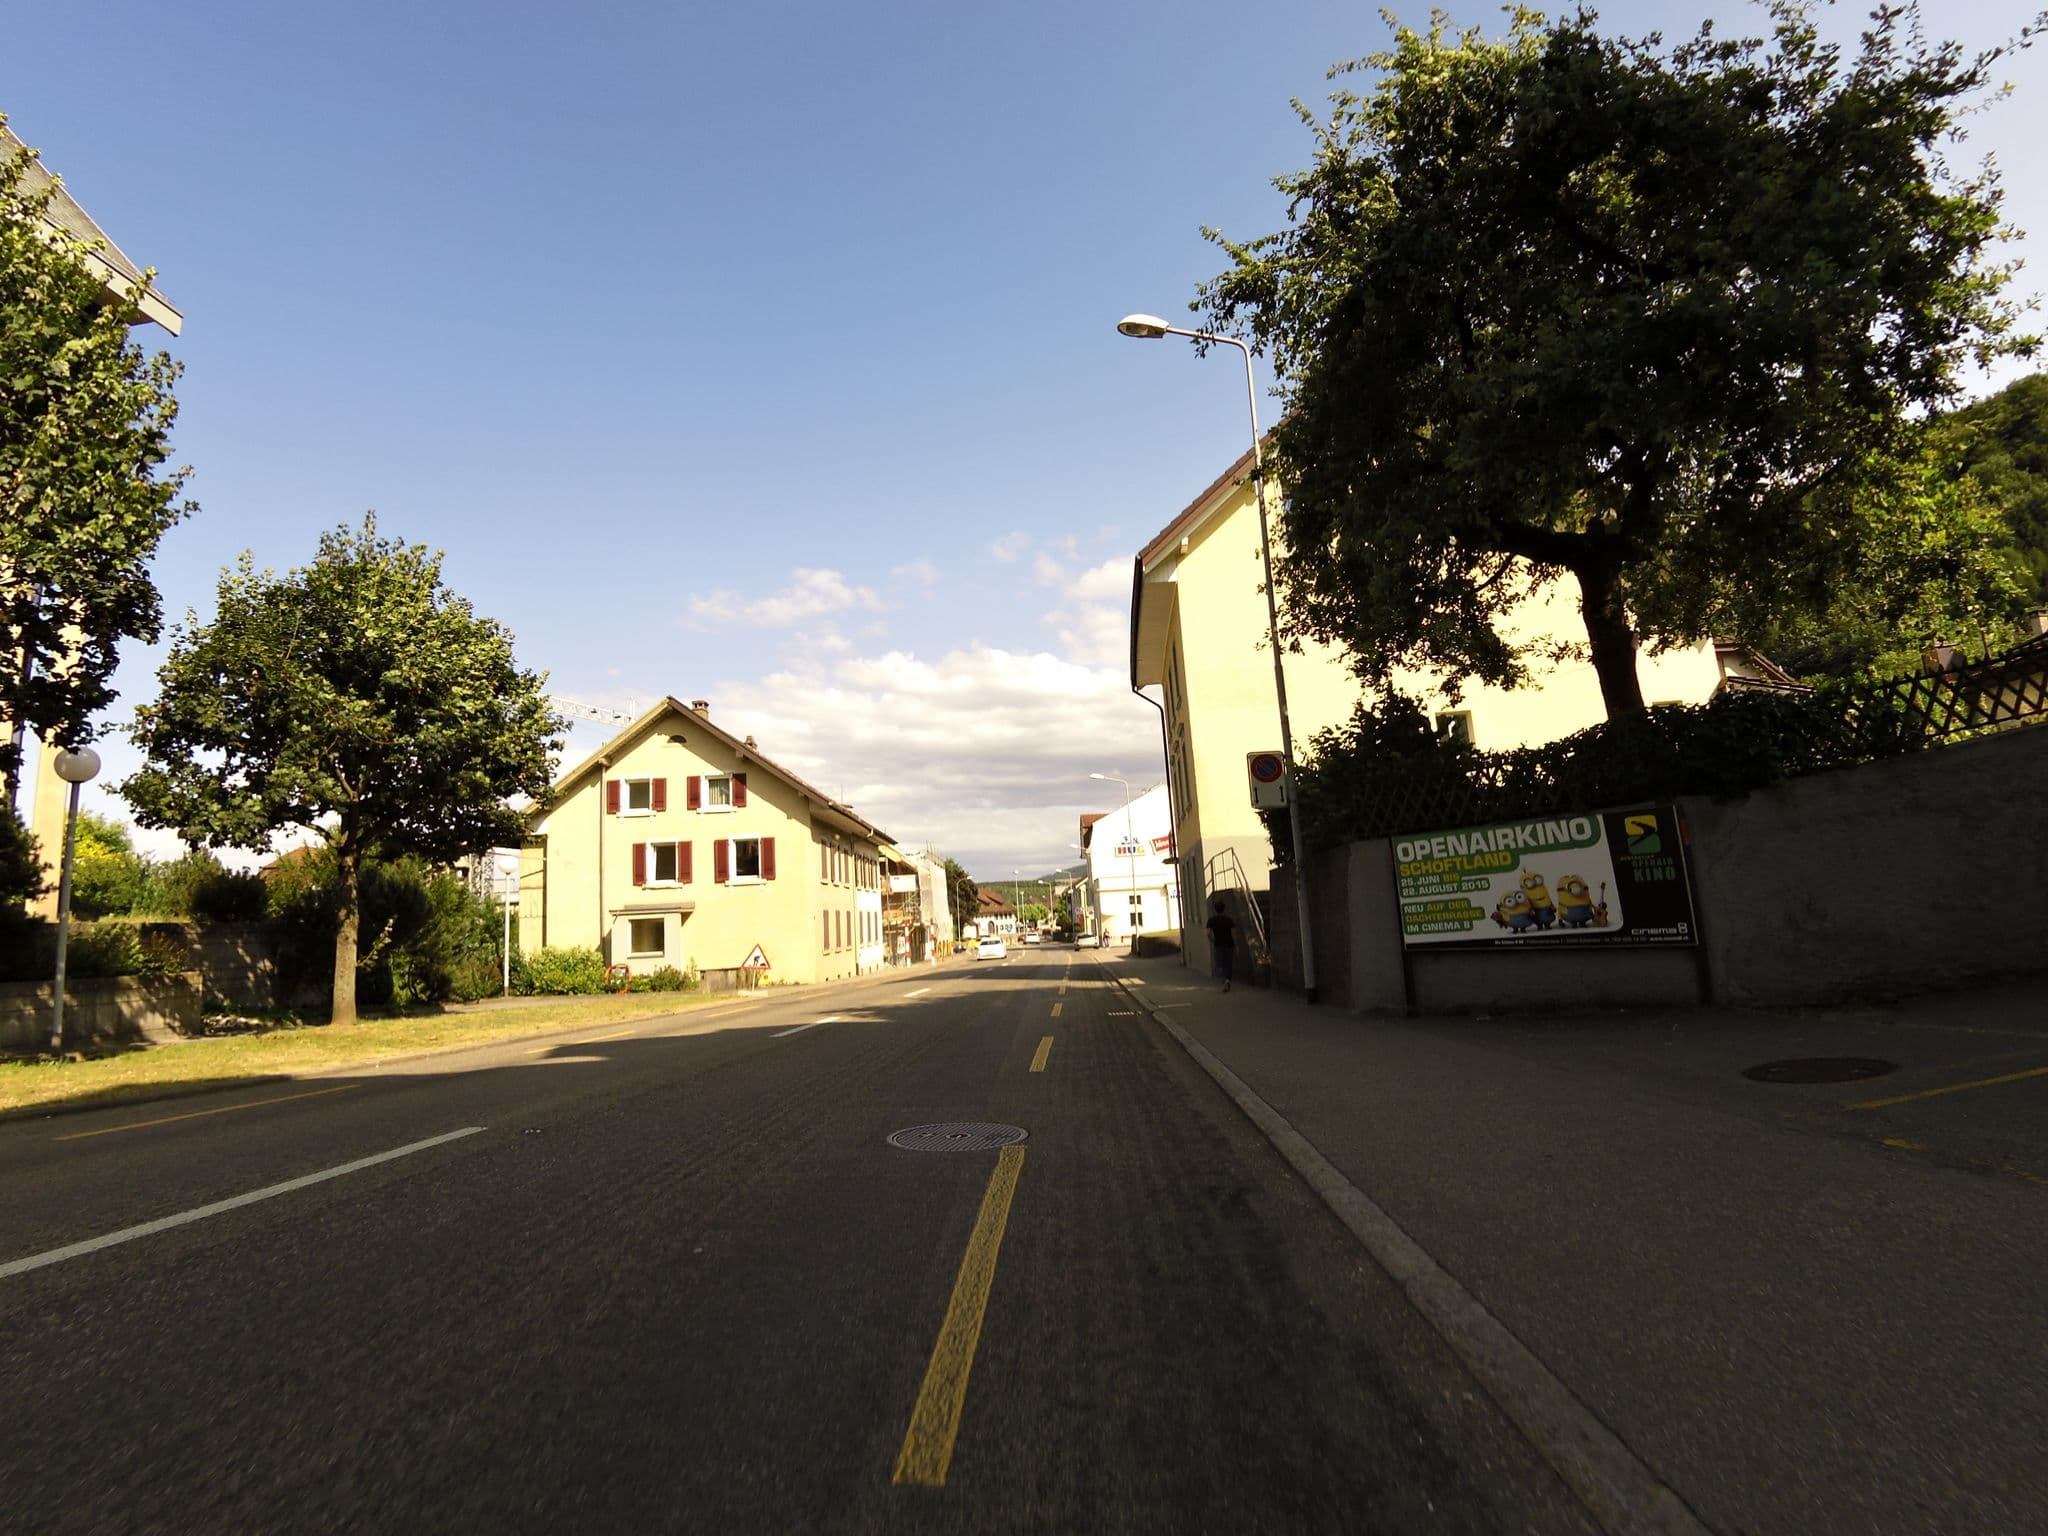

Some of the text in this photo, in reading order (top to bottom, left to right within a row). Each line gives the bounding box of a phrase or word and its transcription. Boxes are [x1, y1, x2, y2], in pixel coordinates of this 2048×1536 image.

[1396, 816, 1593, 863] OPENAIRKINO
[1633, 866, 1676, 882] KINO
[1462, 880, 1489, 890] 2015
[1404, 904, 1424, 913] NEU
[1427, 902, 1445, 912] AUF
[1407, 924, 1419, 933] IM
[1422, 921, 1460, 931] CINEMA
